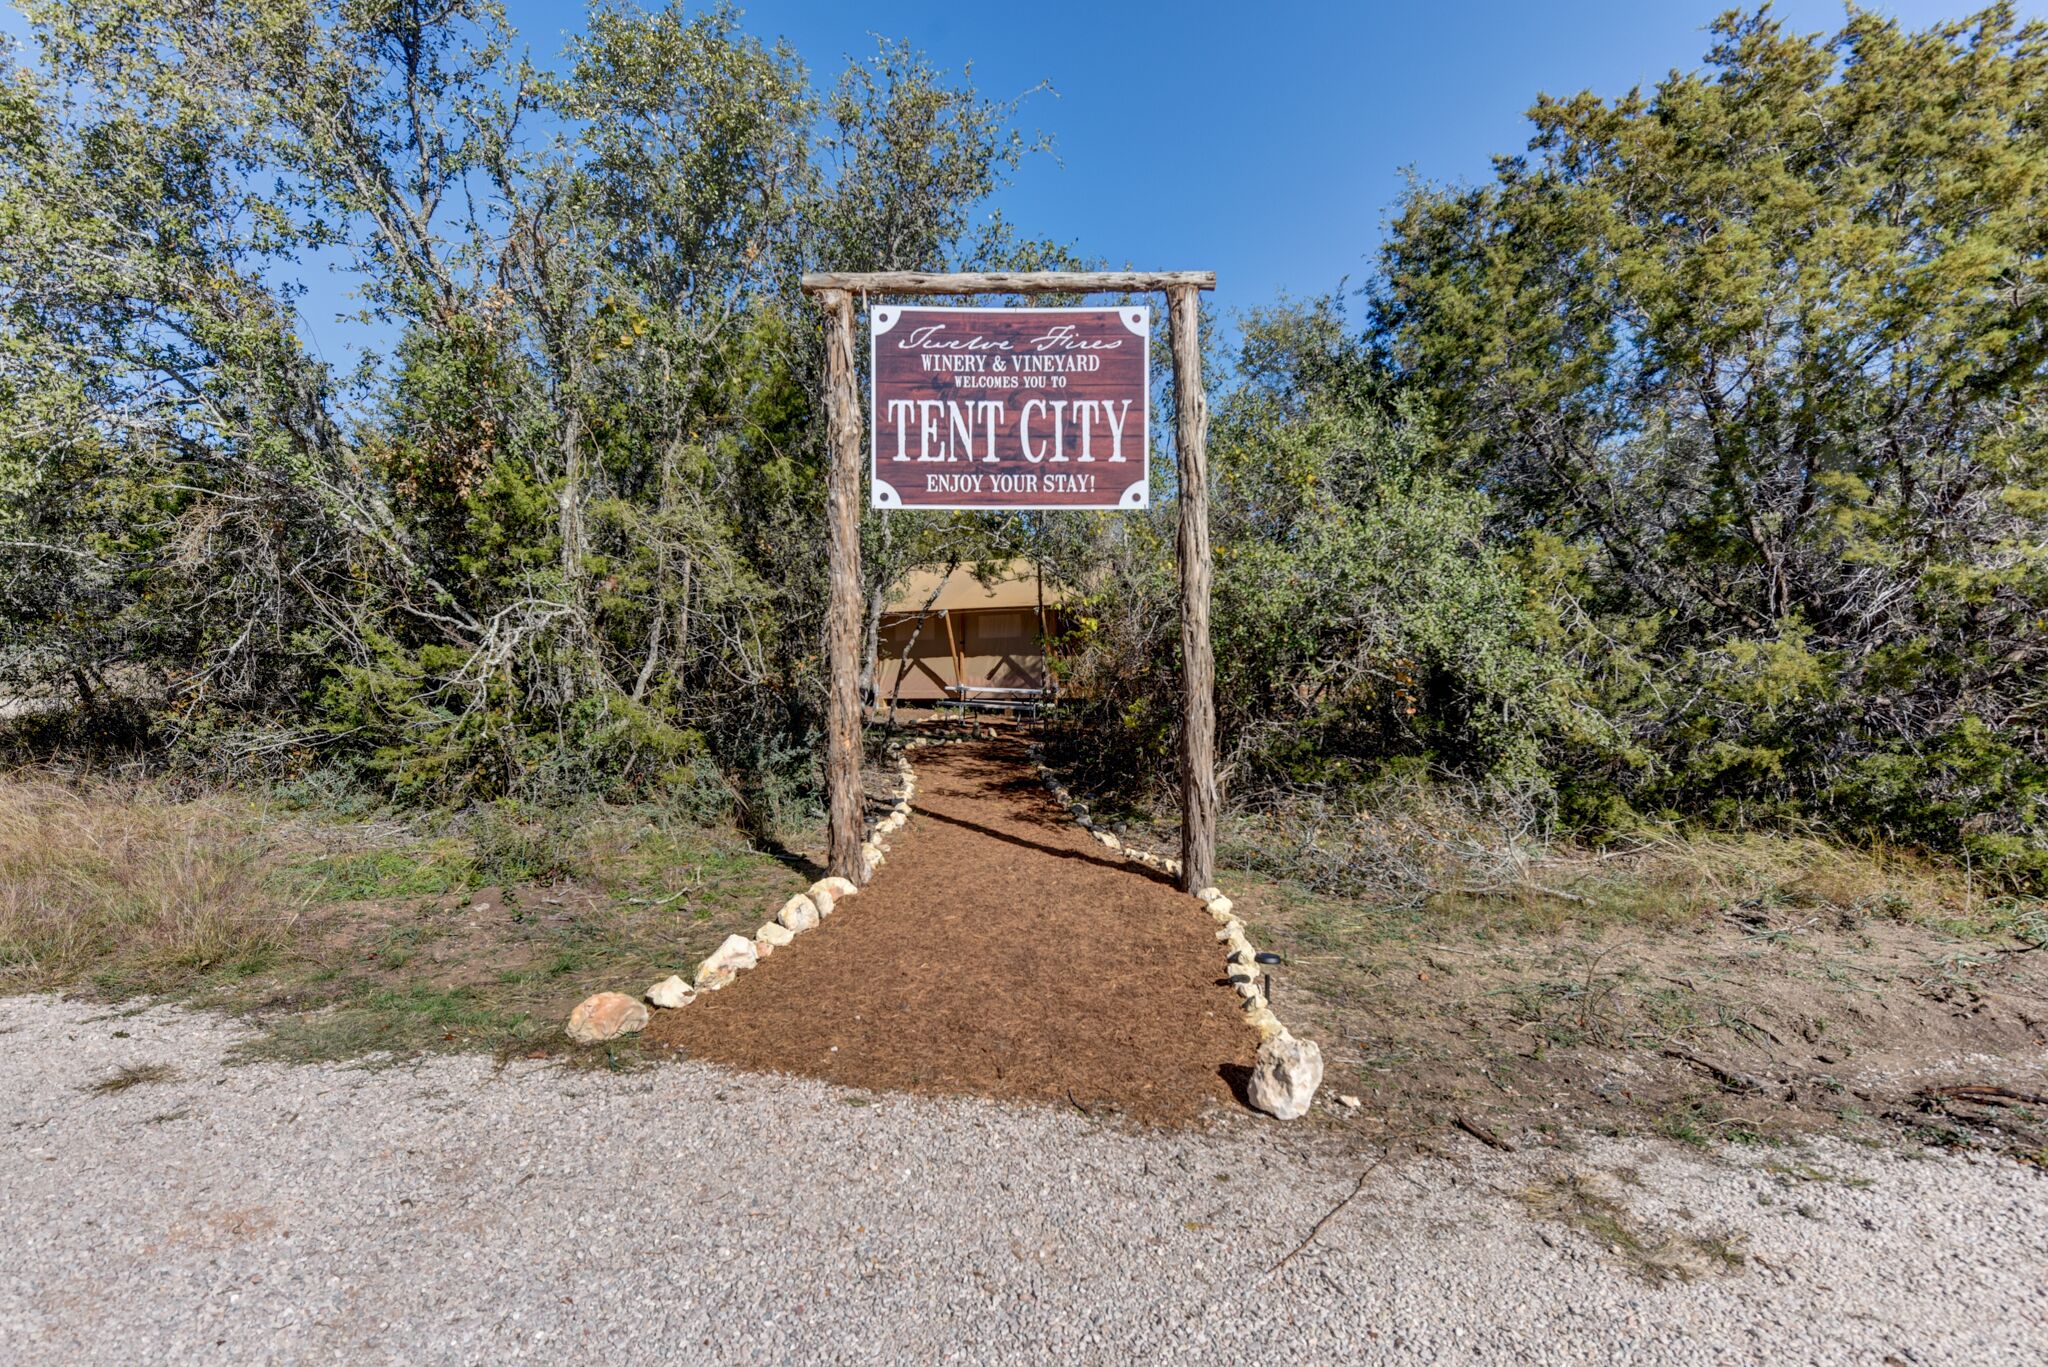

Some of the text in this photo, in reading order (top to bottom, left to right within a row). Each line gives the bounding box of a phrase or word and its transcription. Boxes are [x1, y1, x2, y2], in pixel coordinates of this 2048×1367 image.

[898, 324, 1122, 351] Twelve Fires
[921, 354, 1099, 372] WINERY & VINEYARD
[955, 376, 1066, 388] WELCOMES YOU TO
[888, 400, 1004, 462] TENT
[1020, 399, 1132, 463] CITY
[927, 474, 1095, 492] ENJOY YOUR STAY!
